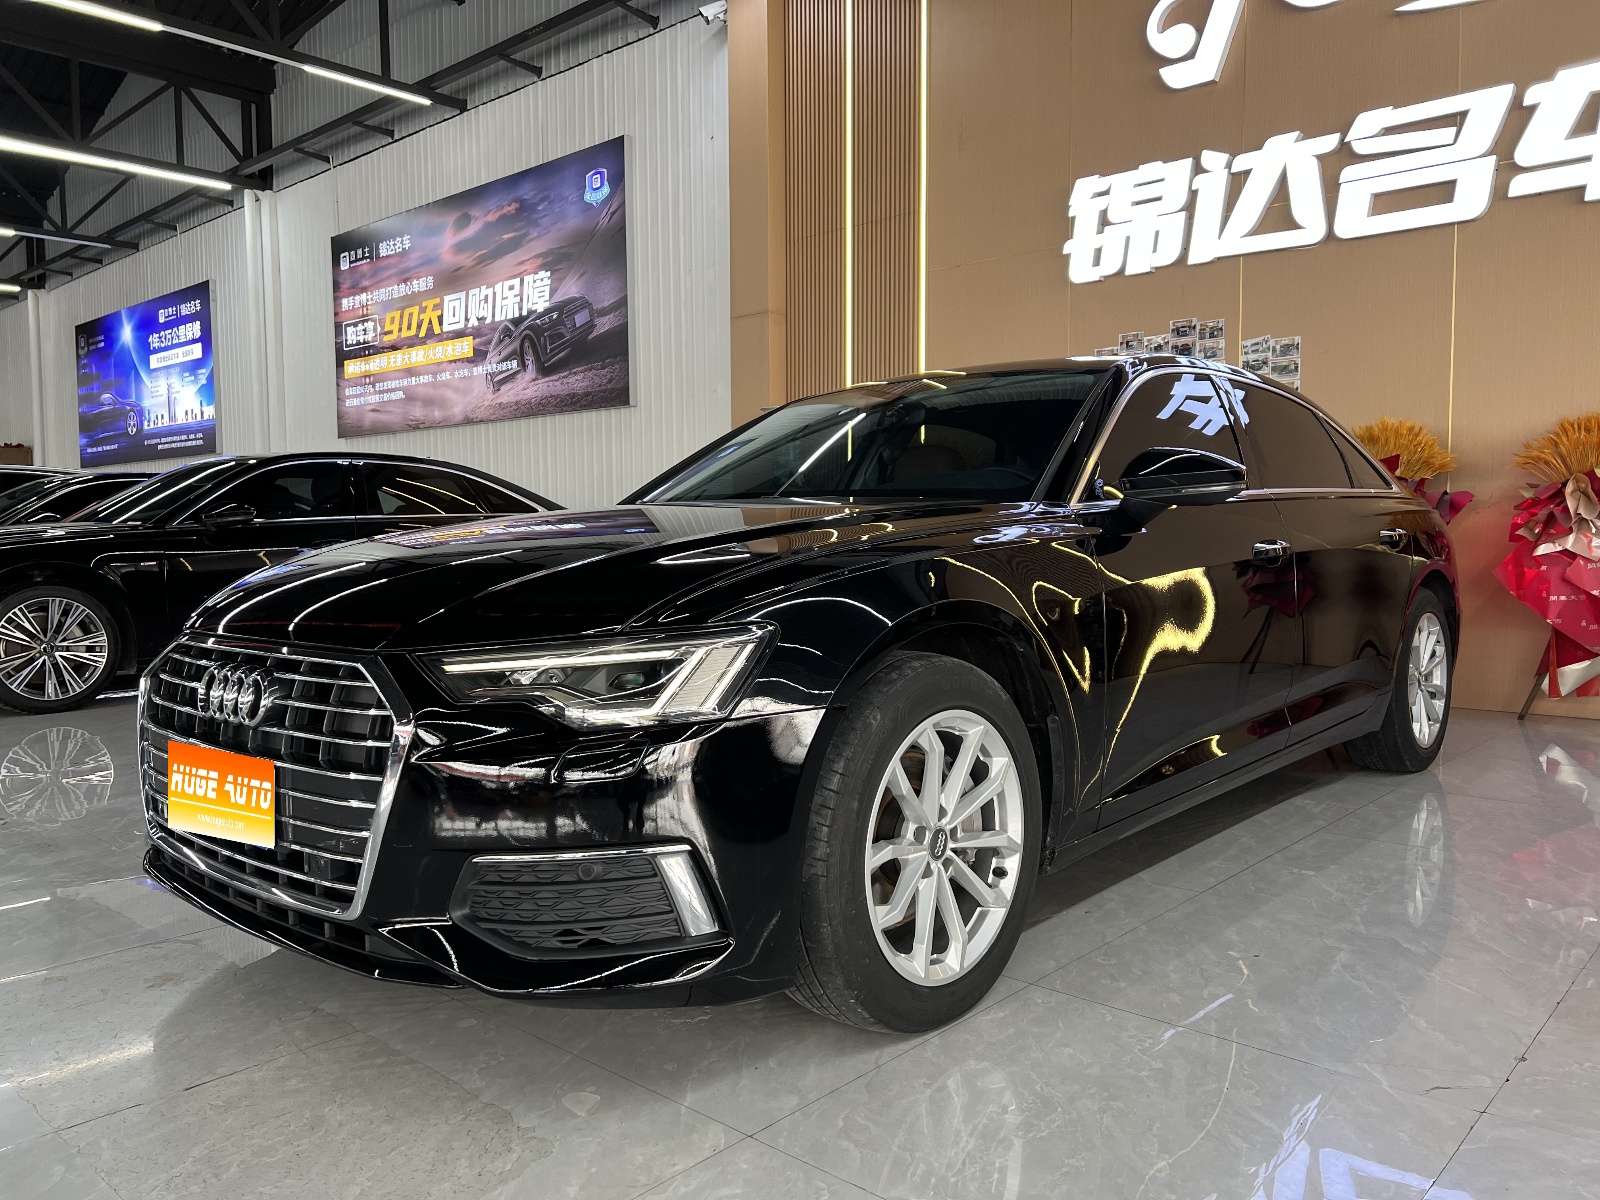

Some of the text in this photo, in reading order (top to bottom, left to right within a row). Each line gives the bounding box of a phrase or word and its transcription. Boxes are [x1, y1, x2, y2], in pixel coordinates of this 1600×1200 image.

[379, 234, 412, 257] 锦达名车
[148, 320, 202, 350] 1年3万公里保修
